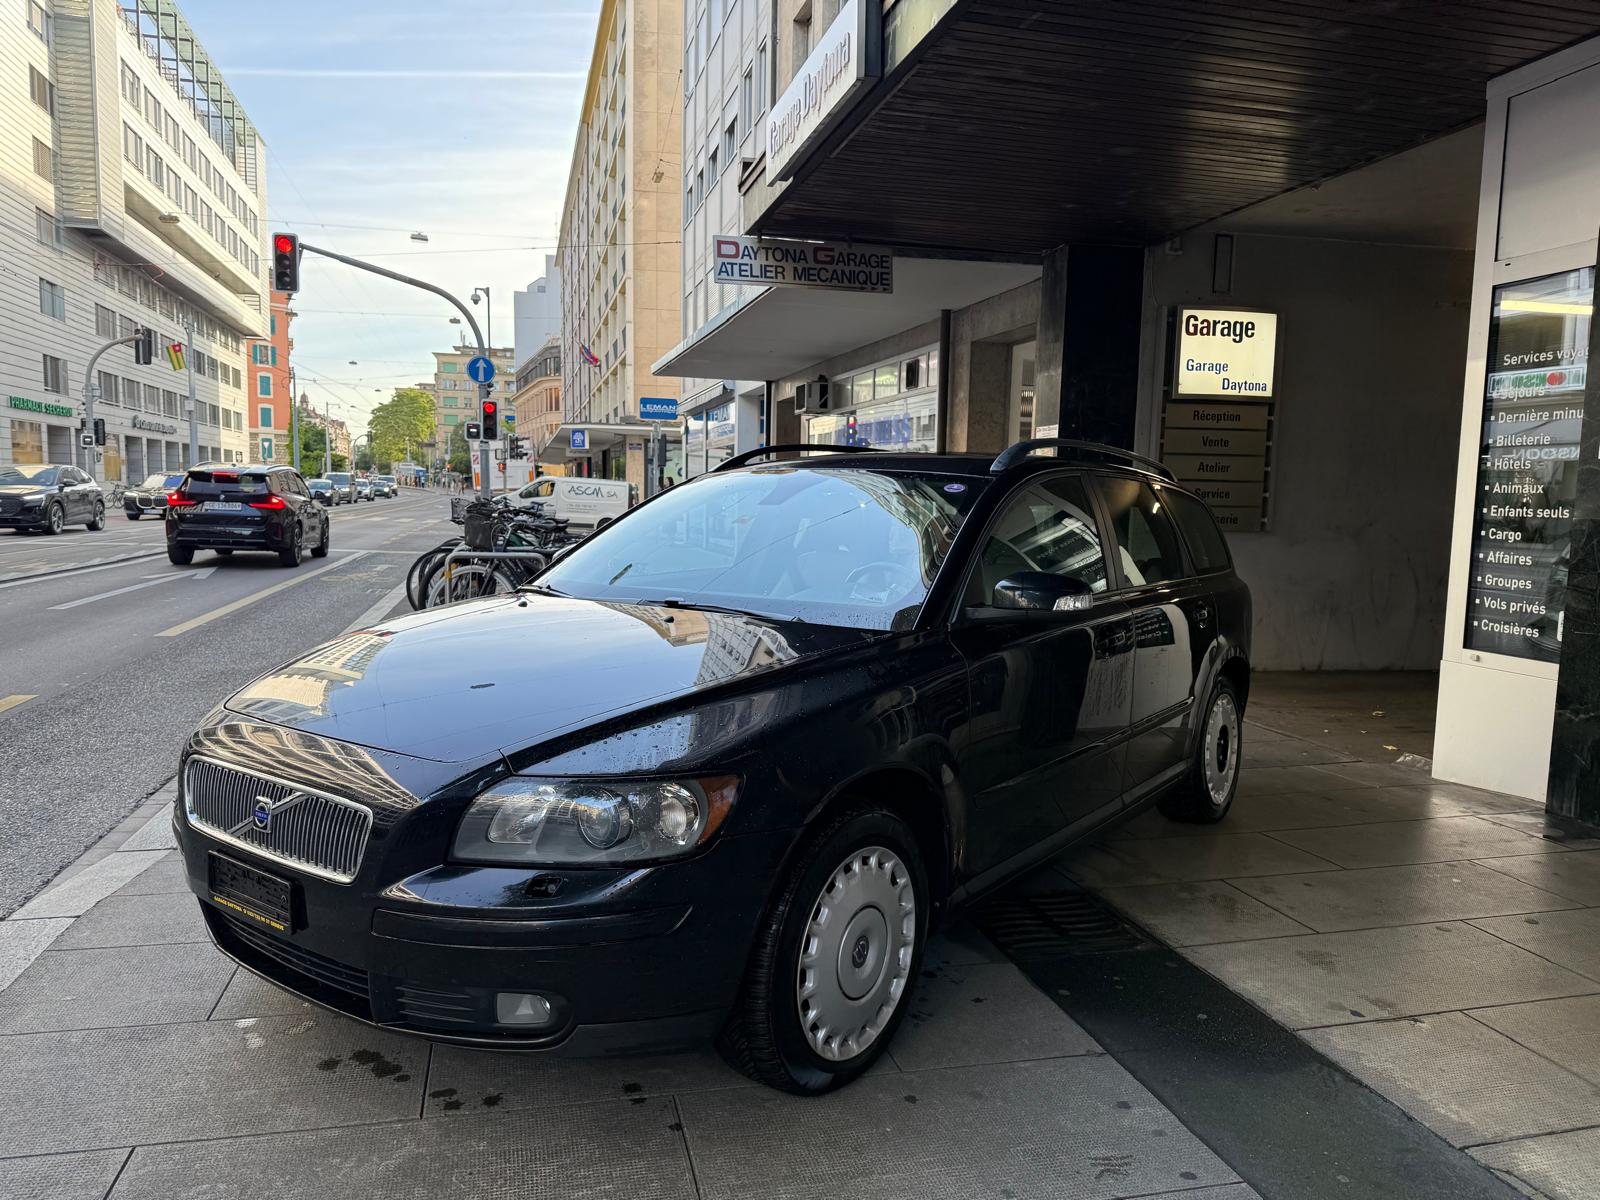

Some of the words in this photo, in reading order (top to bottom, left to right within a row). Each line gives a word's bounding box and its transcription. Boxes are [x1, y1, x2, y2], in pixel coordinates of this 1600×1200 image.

[770, 98, 801, 159] Garage
[803, 31, 851, 119] Daytona
[716, 239, 809, 264] DAYTONA
[813, 246, 890, 270] GARAGE
[717, 261, 786, 281] ATELIER
[793, 266, 891, 287] MECANIQUE
[1184, 314, 1256, 343] Garage
[1503, 350, 1554, 366] Services
[1186, 358, 1229, 375] Garage
[1222, 377, 1267, 394] Daytona
[1192, 409, 1241, 424] Réception
[1498, 409, 1550, 424] Dernière
[1202, 436, 1229, 448] Vente
[1496, 433, 1551, 447] Billeterie
[1197, 461, 1231, 474] Atelier
[1494, 458, 1531, 470] Hôtels
[568, 485, 604, 498] ASCM
[1194, 487, 1231, 500] Service
[1492, 482, 1544, 494] Animaux
[1490, 505, 1534, 518] Enfants
[1536, 506, 1570, 519] seuls
[1489, 528, 1522, 542] Cargo
[1487, 552, 1533, 566] Affaires
[1485, 574, 1532, 589] Groupes
[1483, 596, 1507, 610] Vols
[1509, 603, 1546, 616] privés
[1481, 620, 1540, 638] Croisières
